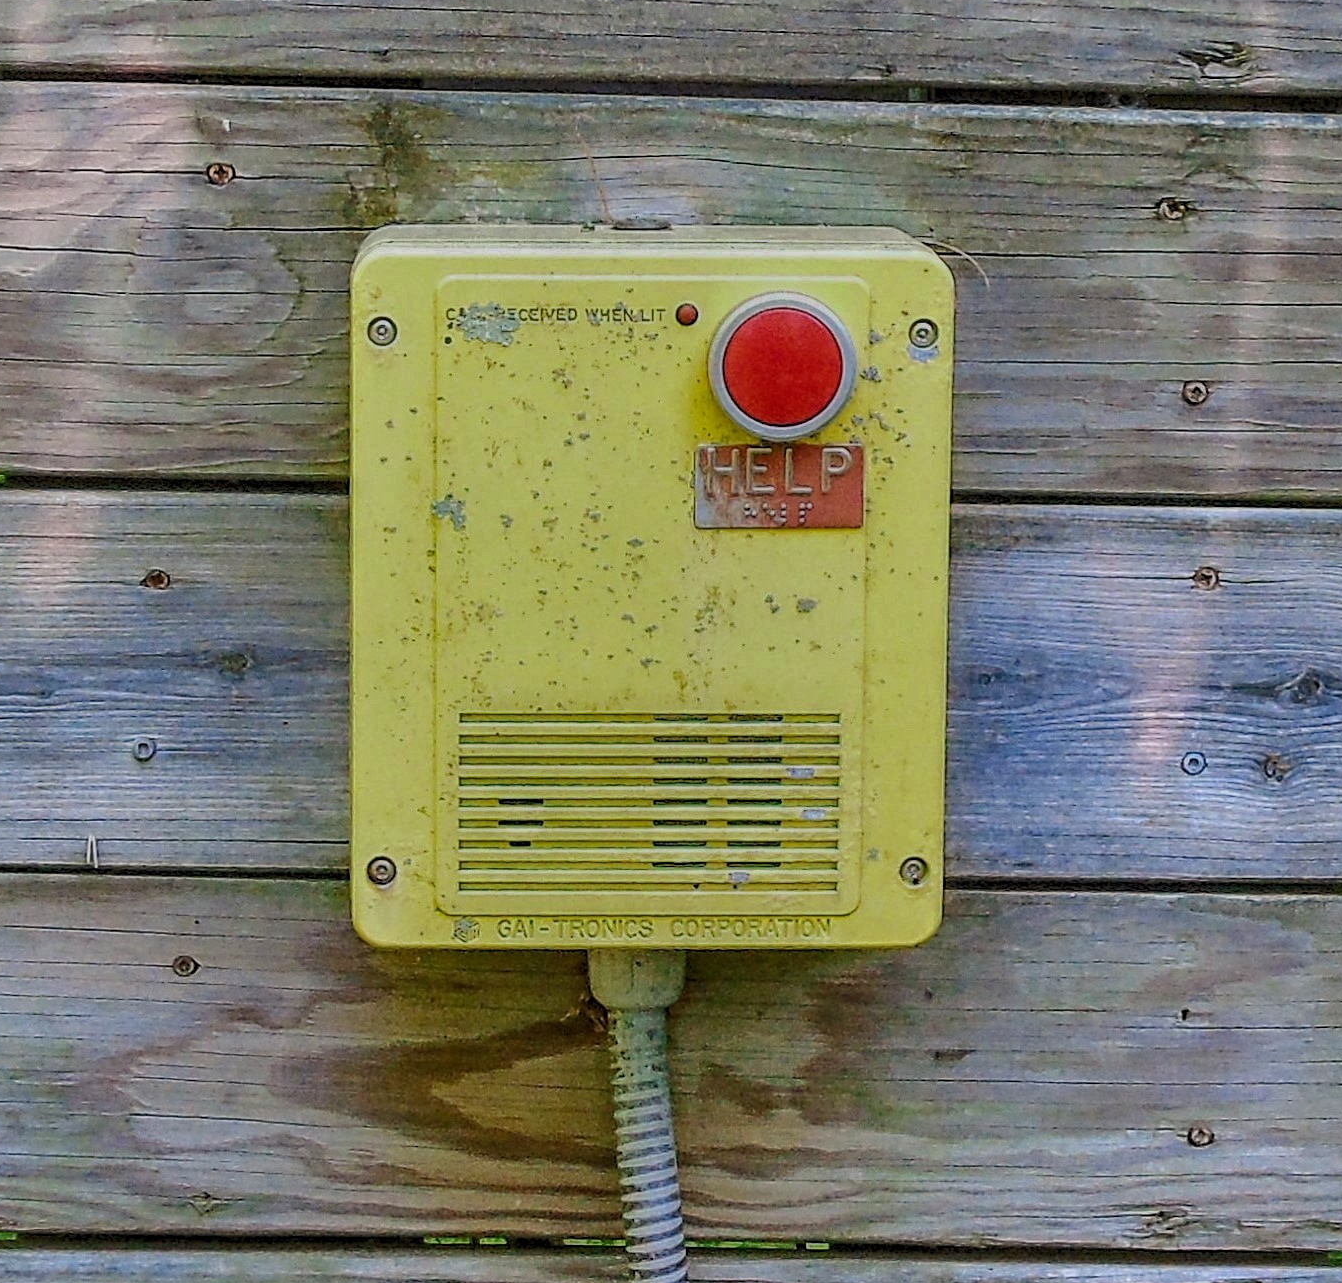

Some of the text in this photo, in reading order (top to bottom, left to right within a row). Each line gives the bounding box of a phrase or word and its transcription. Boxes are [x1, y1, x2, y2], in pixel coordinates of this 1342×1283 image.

[585, 307, 634, 322] WHEN
[642, 307, 667, 322] LIT
[705, 446, 853, 495] HELP
[497, 919, 833, 939] GAI-TRONICS CORPORATION
